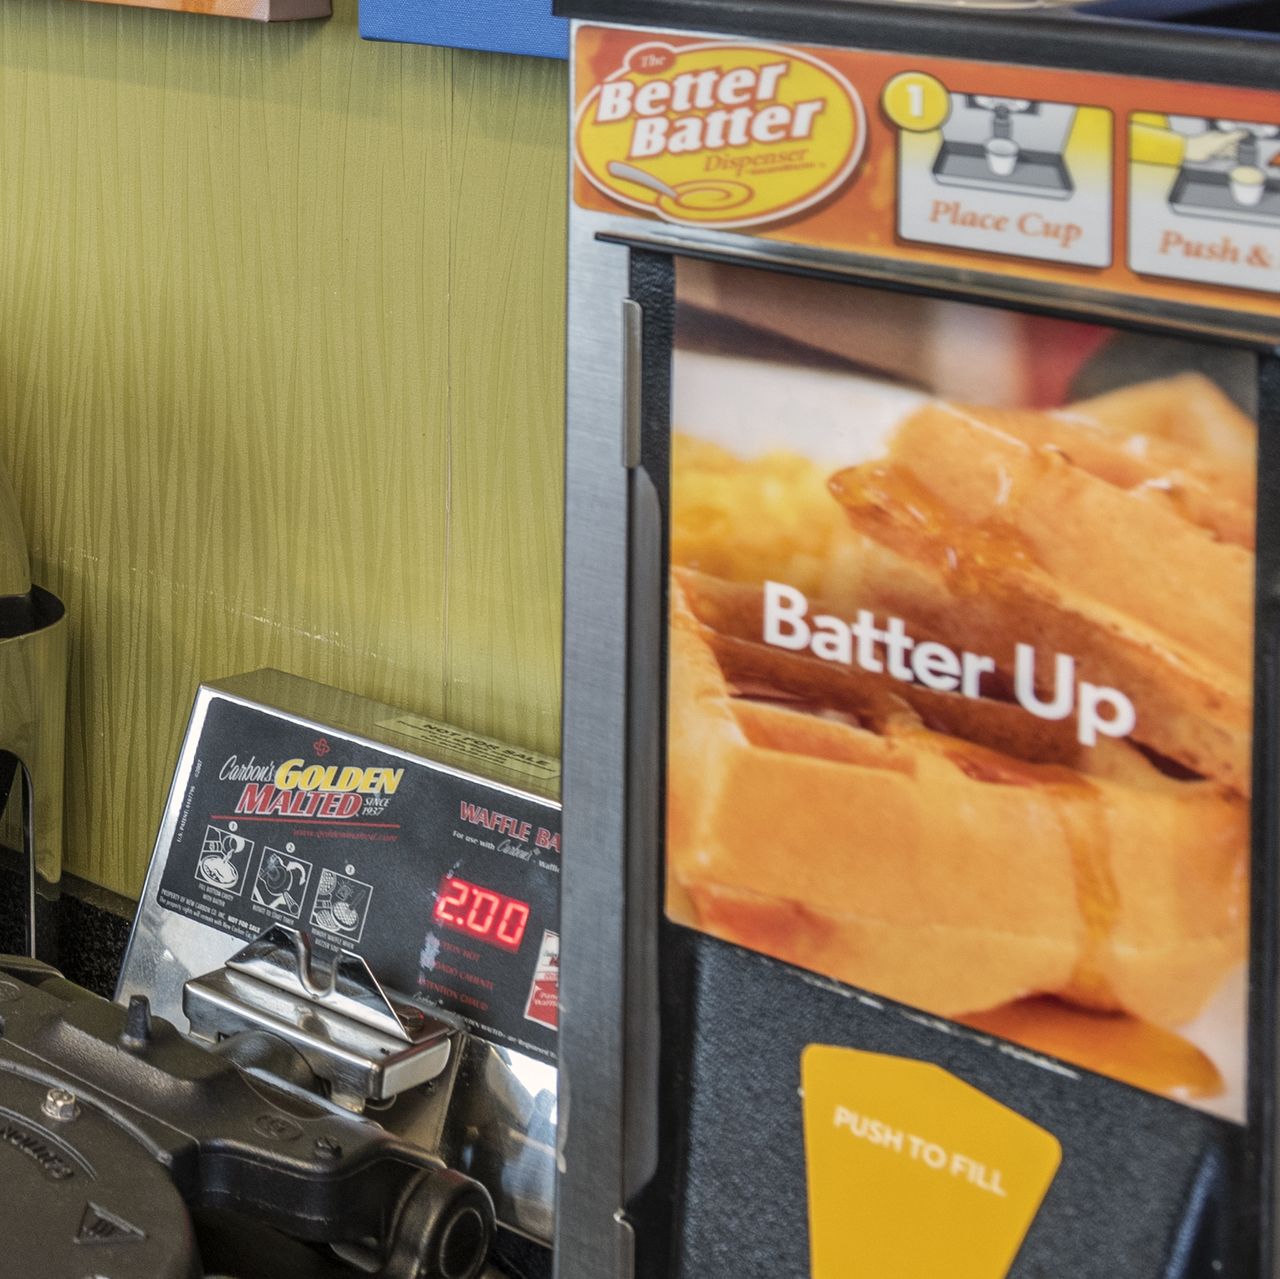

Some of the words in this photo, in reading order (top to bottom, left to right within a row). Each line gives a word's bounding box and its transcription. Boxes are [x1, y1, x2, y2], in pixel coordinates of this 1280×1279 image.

[640, 54, 667, 68] The
[596, 63, 788, 123] Better
[906, 83, 924, 118] 1
[629, 100, 824, 158] Batter
[704, 148, 810, 177] Dispenser
[929, 199, 1009, 234] Place
[1016, 210, 1084, 249] Cup
[1158, 230, 1242, 266] Push
[1244, 243, 1272, 268] &
[762, 580, 995, 699] Batter
[1013, 643, 1137, 747] Up
[422, 722, 460, 739] NOT
[463, 735, 498, 750] FOR
[501, 748, 551, 767] SALE
[274, 758, 405, 795] GOLDEN
[235, 782, 361, 819] MALTED
[362, 806, 385, 817] 1937
[363, 797, 391, 808] SINCE
[452, 830, 465, 839] For
[465, 835, 479, 843] use
[479, 840, 495, 851] with
[459, 800, 533, 843] WAFFLE
[535, 827, 561, 854] BA
[833, 1104, 905, 1153] PUSH
[908, 1135, 949, 1169] TO
[950, 1152, 1007, 1198] FILL
